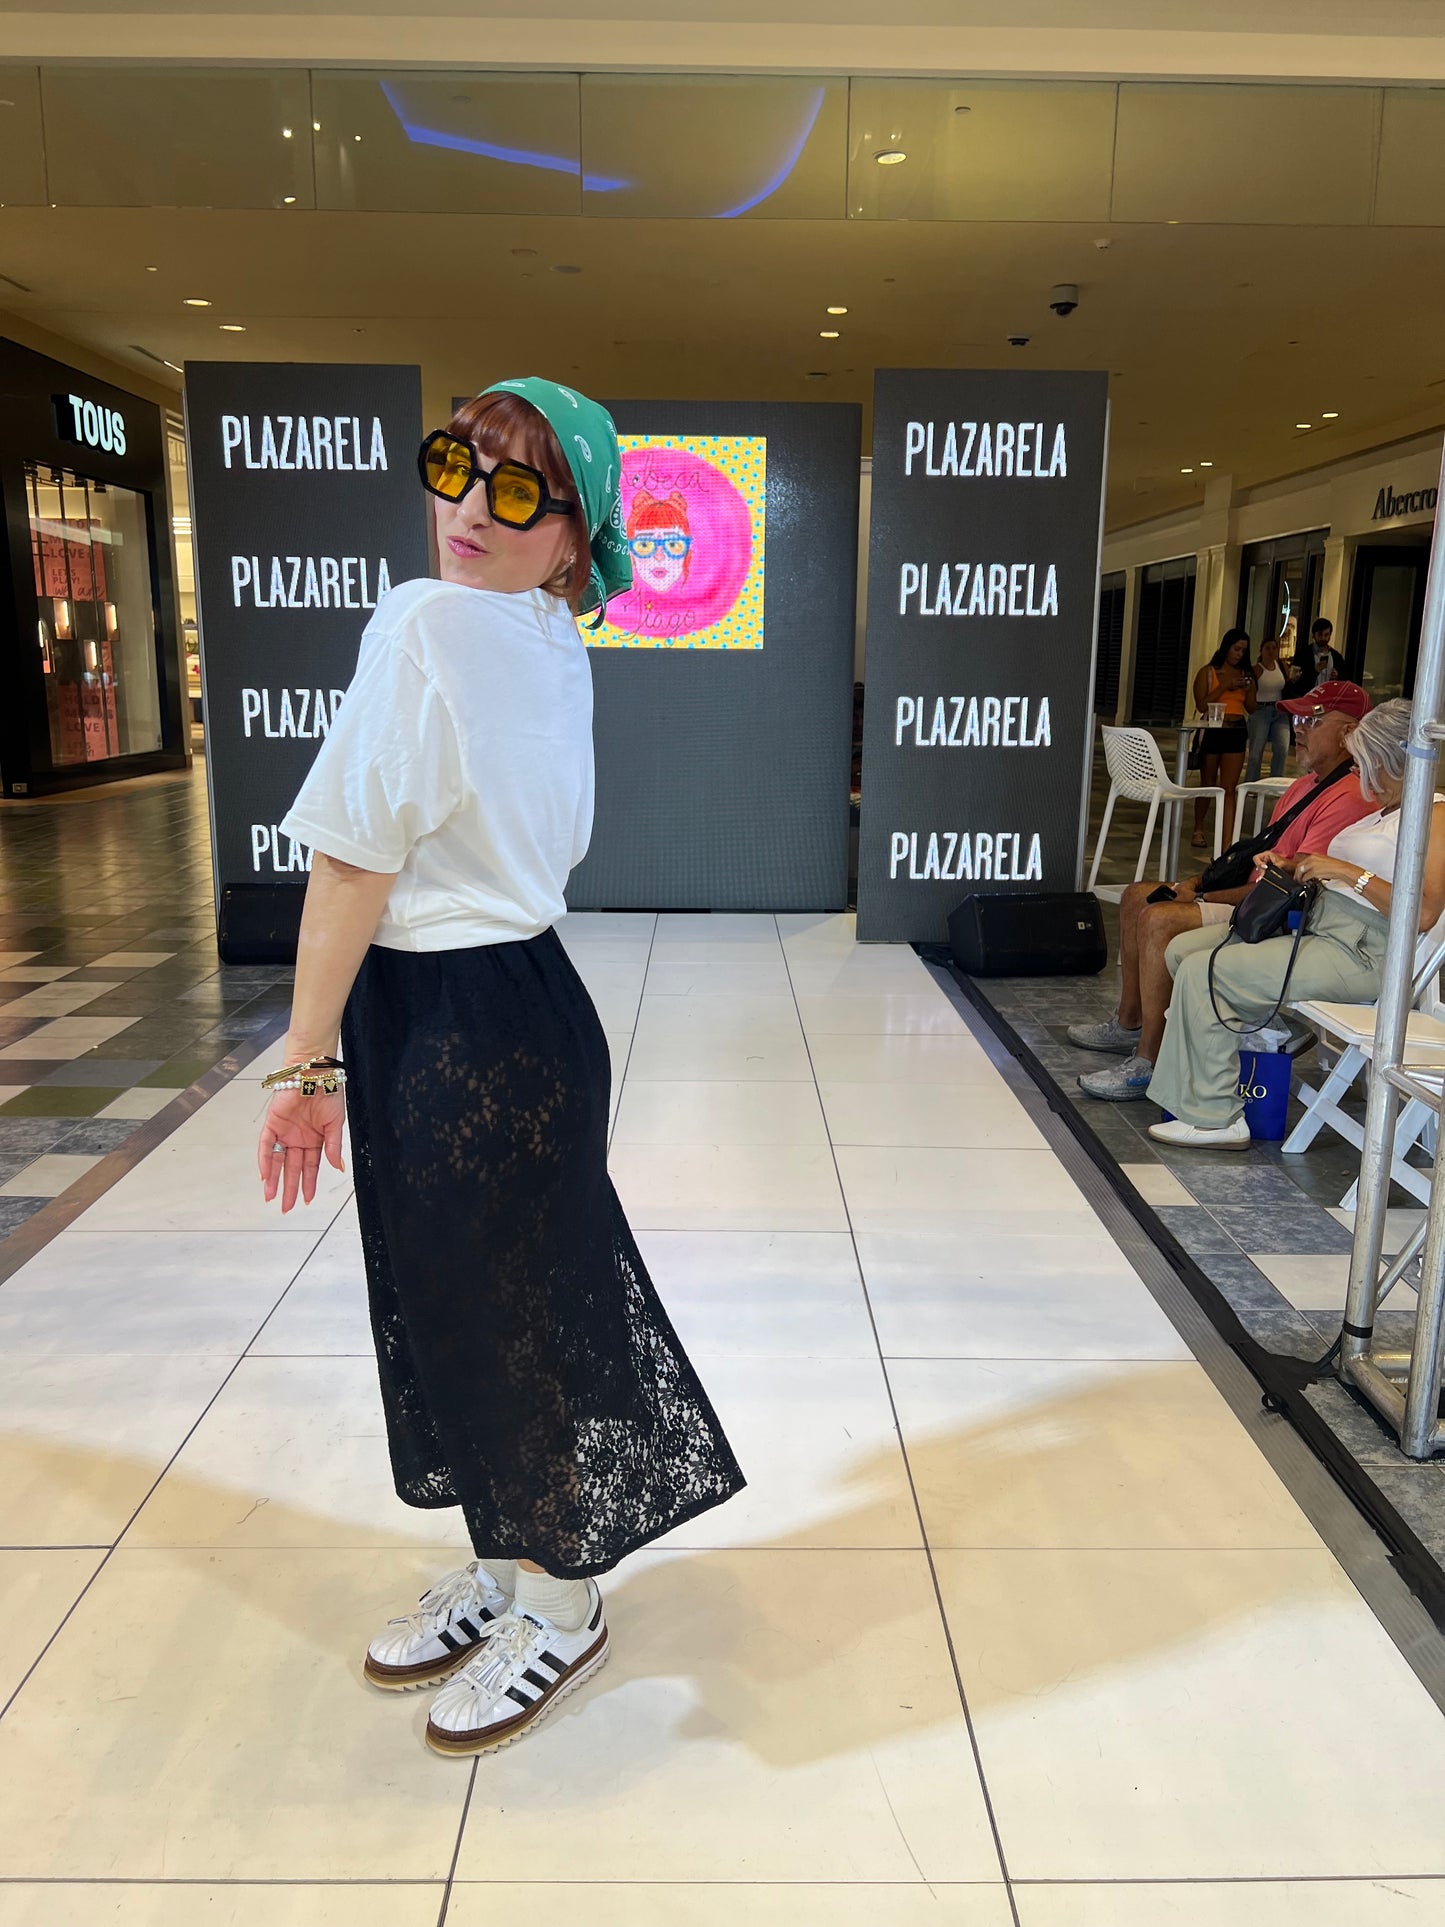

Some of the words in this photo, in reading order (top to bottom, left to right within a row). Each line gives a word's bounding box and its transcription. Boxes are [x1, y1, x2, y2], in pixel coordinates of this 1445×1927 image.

[68, 393, 127, 456] TOUS
[221, 415, 388, 471] PLAZARELA
[905, 421, 1067, 477] PLAZARELA
[231, 556, 392, 609] PLAZARELA
[899, 563, 1059, 616] PLAZARELA
[895, 696, 1051, 747] PLAZARELA
[890, 831, 1043, 881] PLAZARELA
